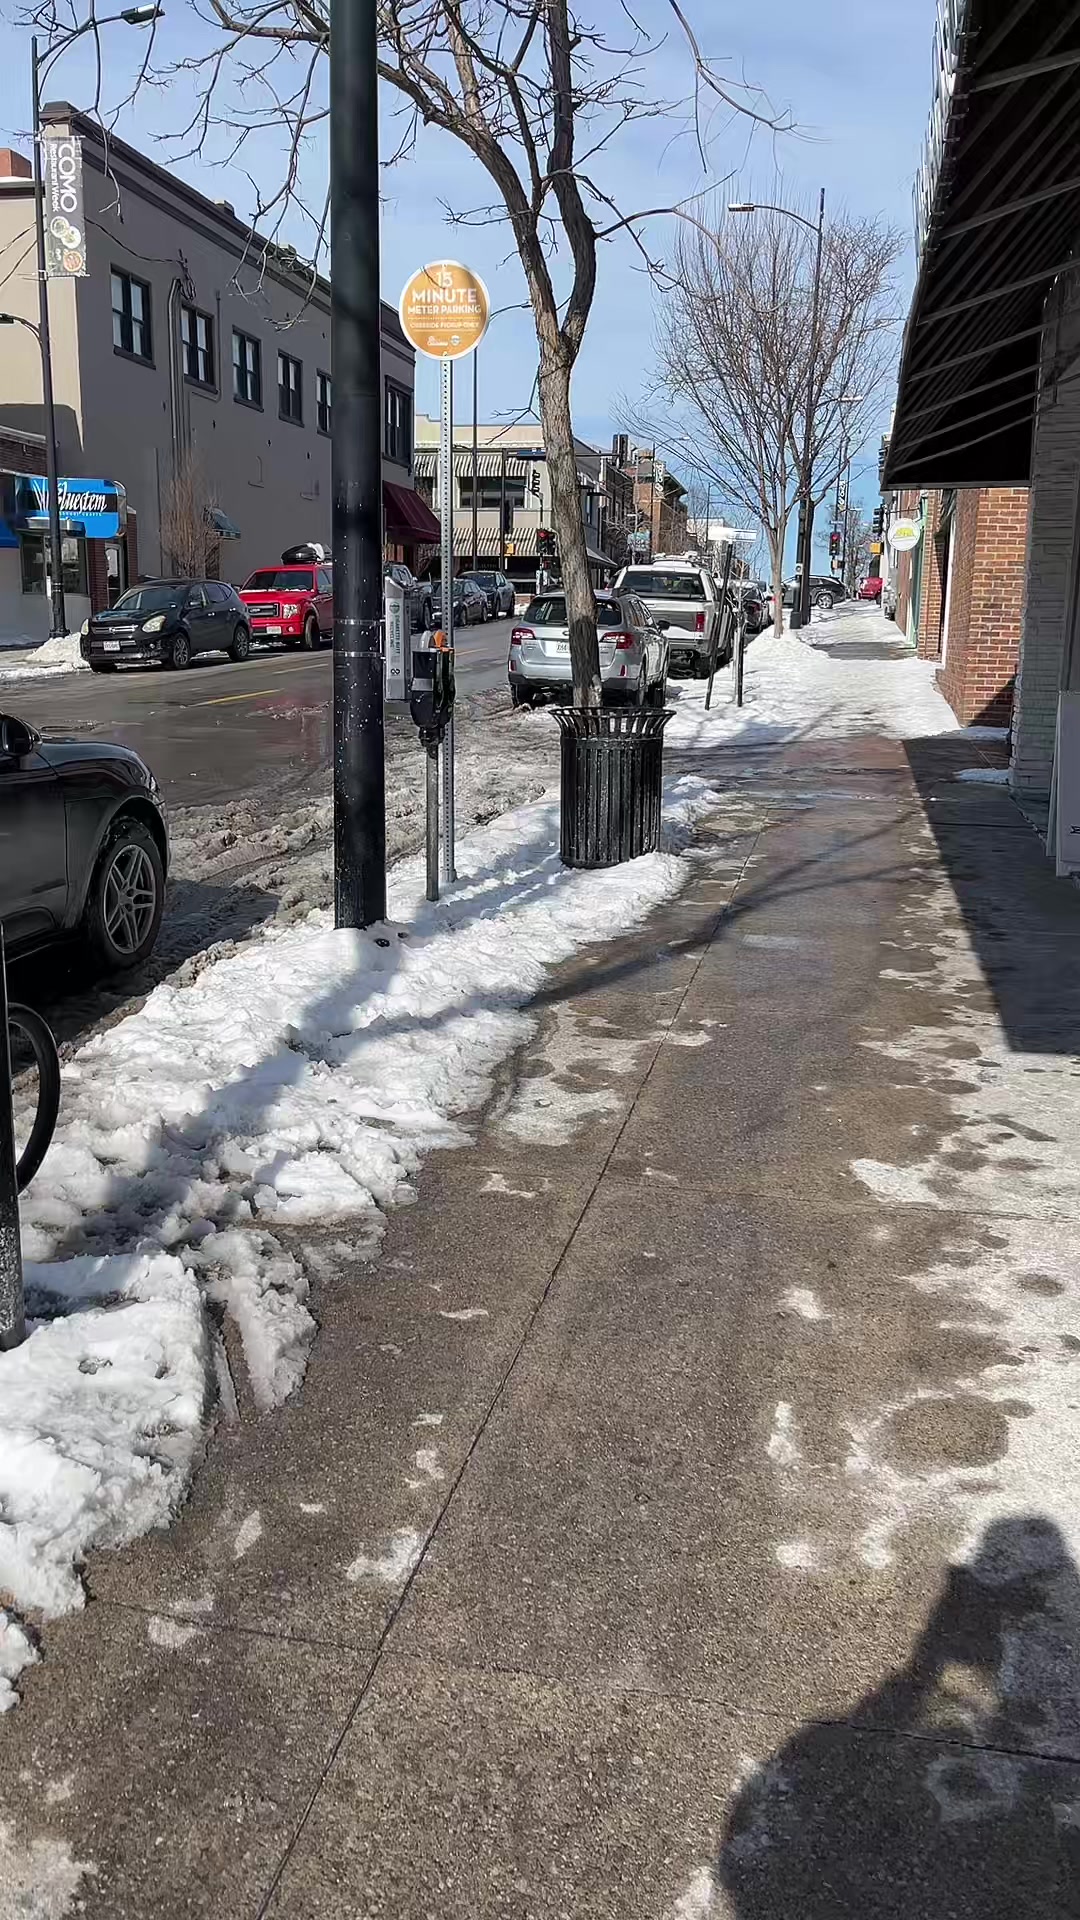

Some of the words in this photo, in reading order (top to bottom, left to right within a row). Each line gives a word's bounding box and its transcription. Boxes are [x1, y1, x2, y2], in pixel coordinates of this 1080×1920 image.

[49, 143, 59, 186] Restaurant
[58, 144, 77, 213] COMO
[52, 185, 61, 212] Week
[437, 271, 453, 287] 15
[412, 288, 477, 304] MINUTE
[407, 305, 439, 315] METER
[440, 304, 482, 314] PARKING
